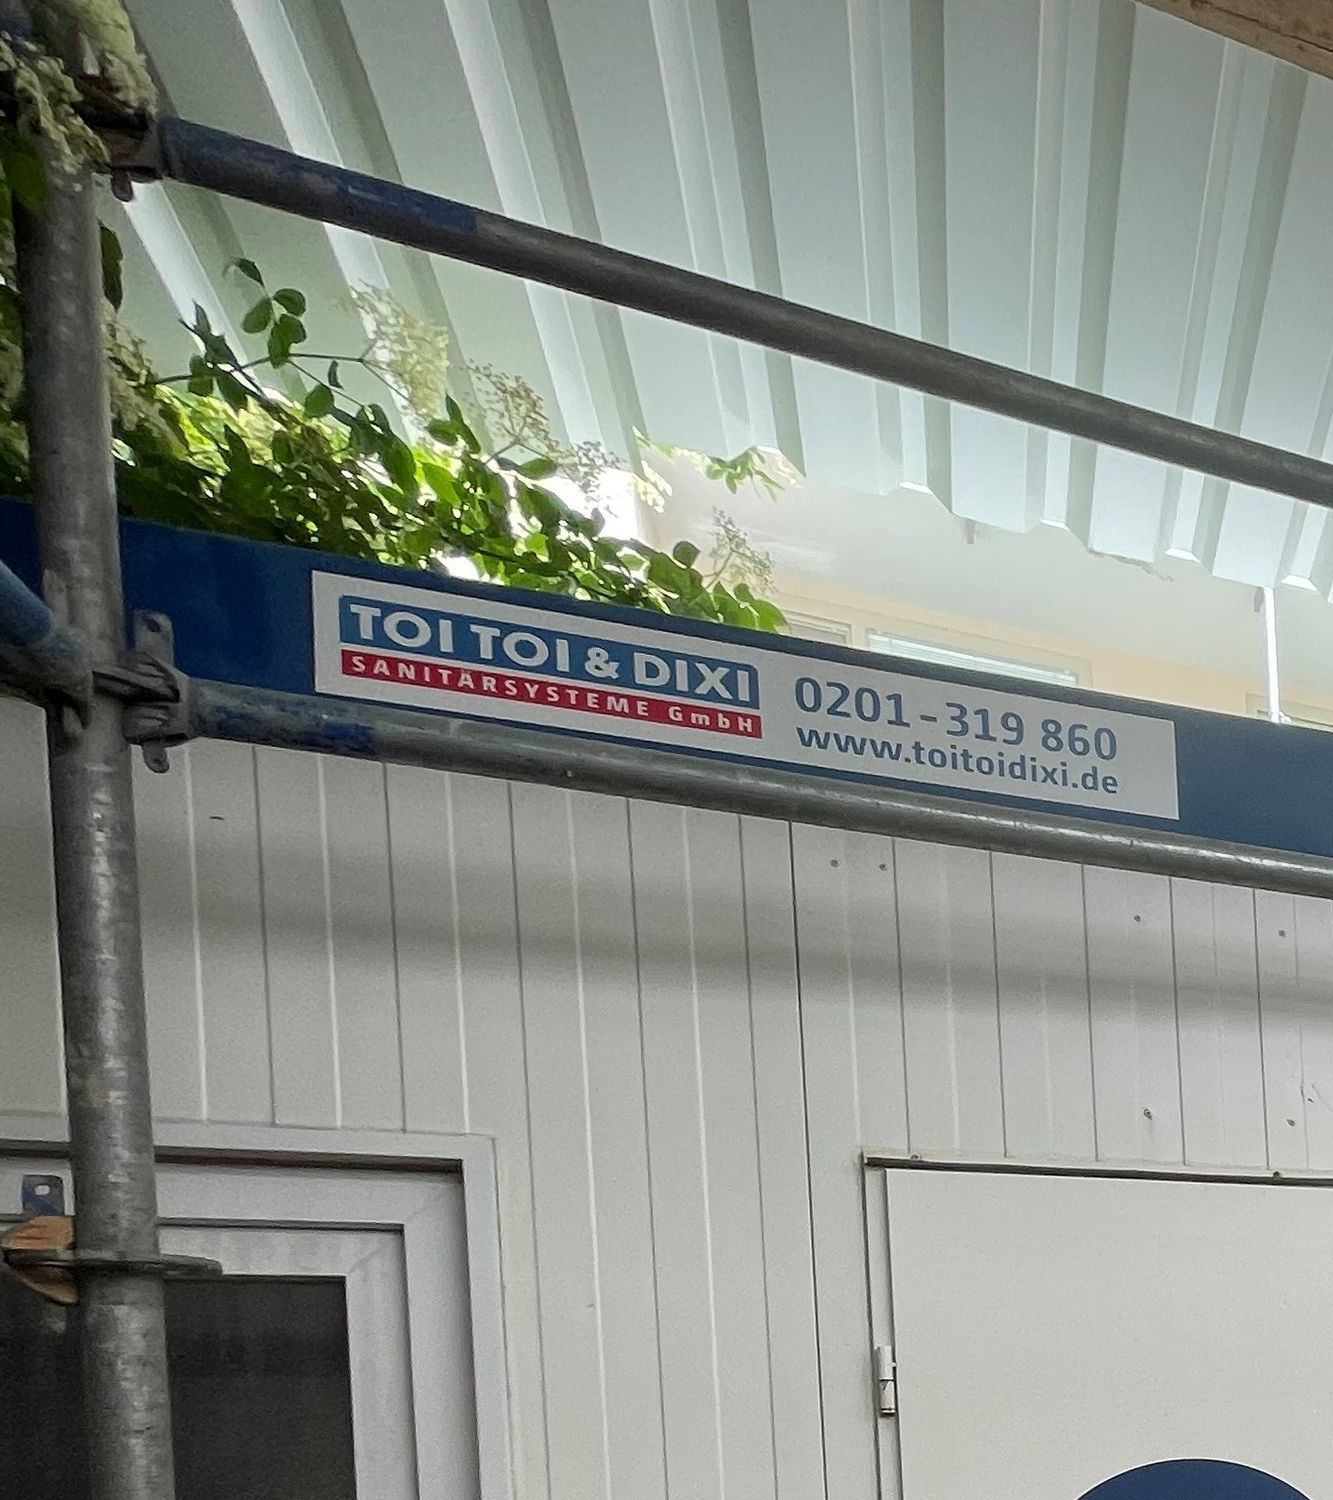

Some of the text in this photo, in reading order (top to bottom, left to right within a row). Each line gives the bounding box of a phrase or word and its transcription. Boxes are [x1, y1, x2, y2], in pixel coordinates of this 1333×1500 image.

[350, 603, 750, 702] TOI TOI & DIXI
[352, 656, 754, 733] SANITÄRSYSTEME GmbH
[796, 727, 1119, 794] www.toitoidixi.de
[1041, 719, 1117, 760] 860
